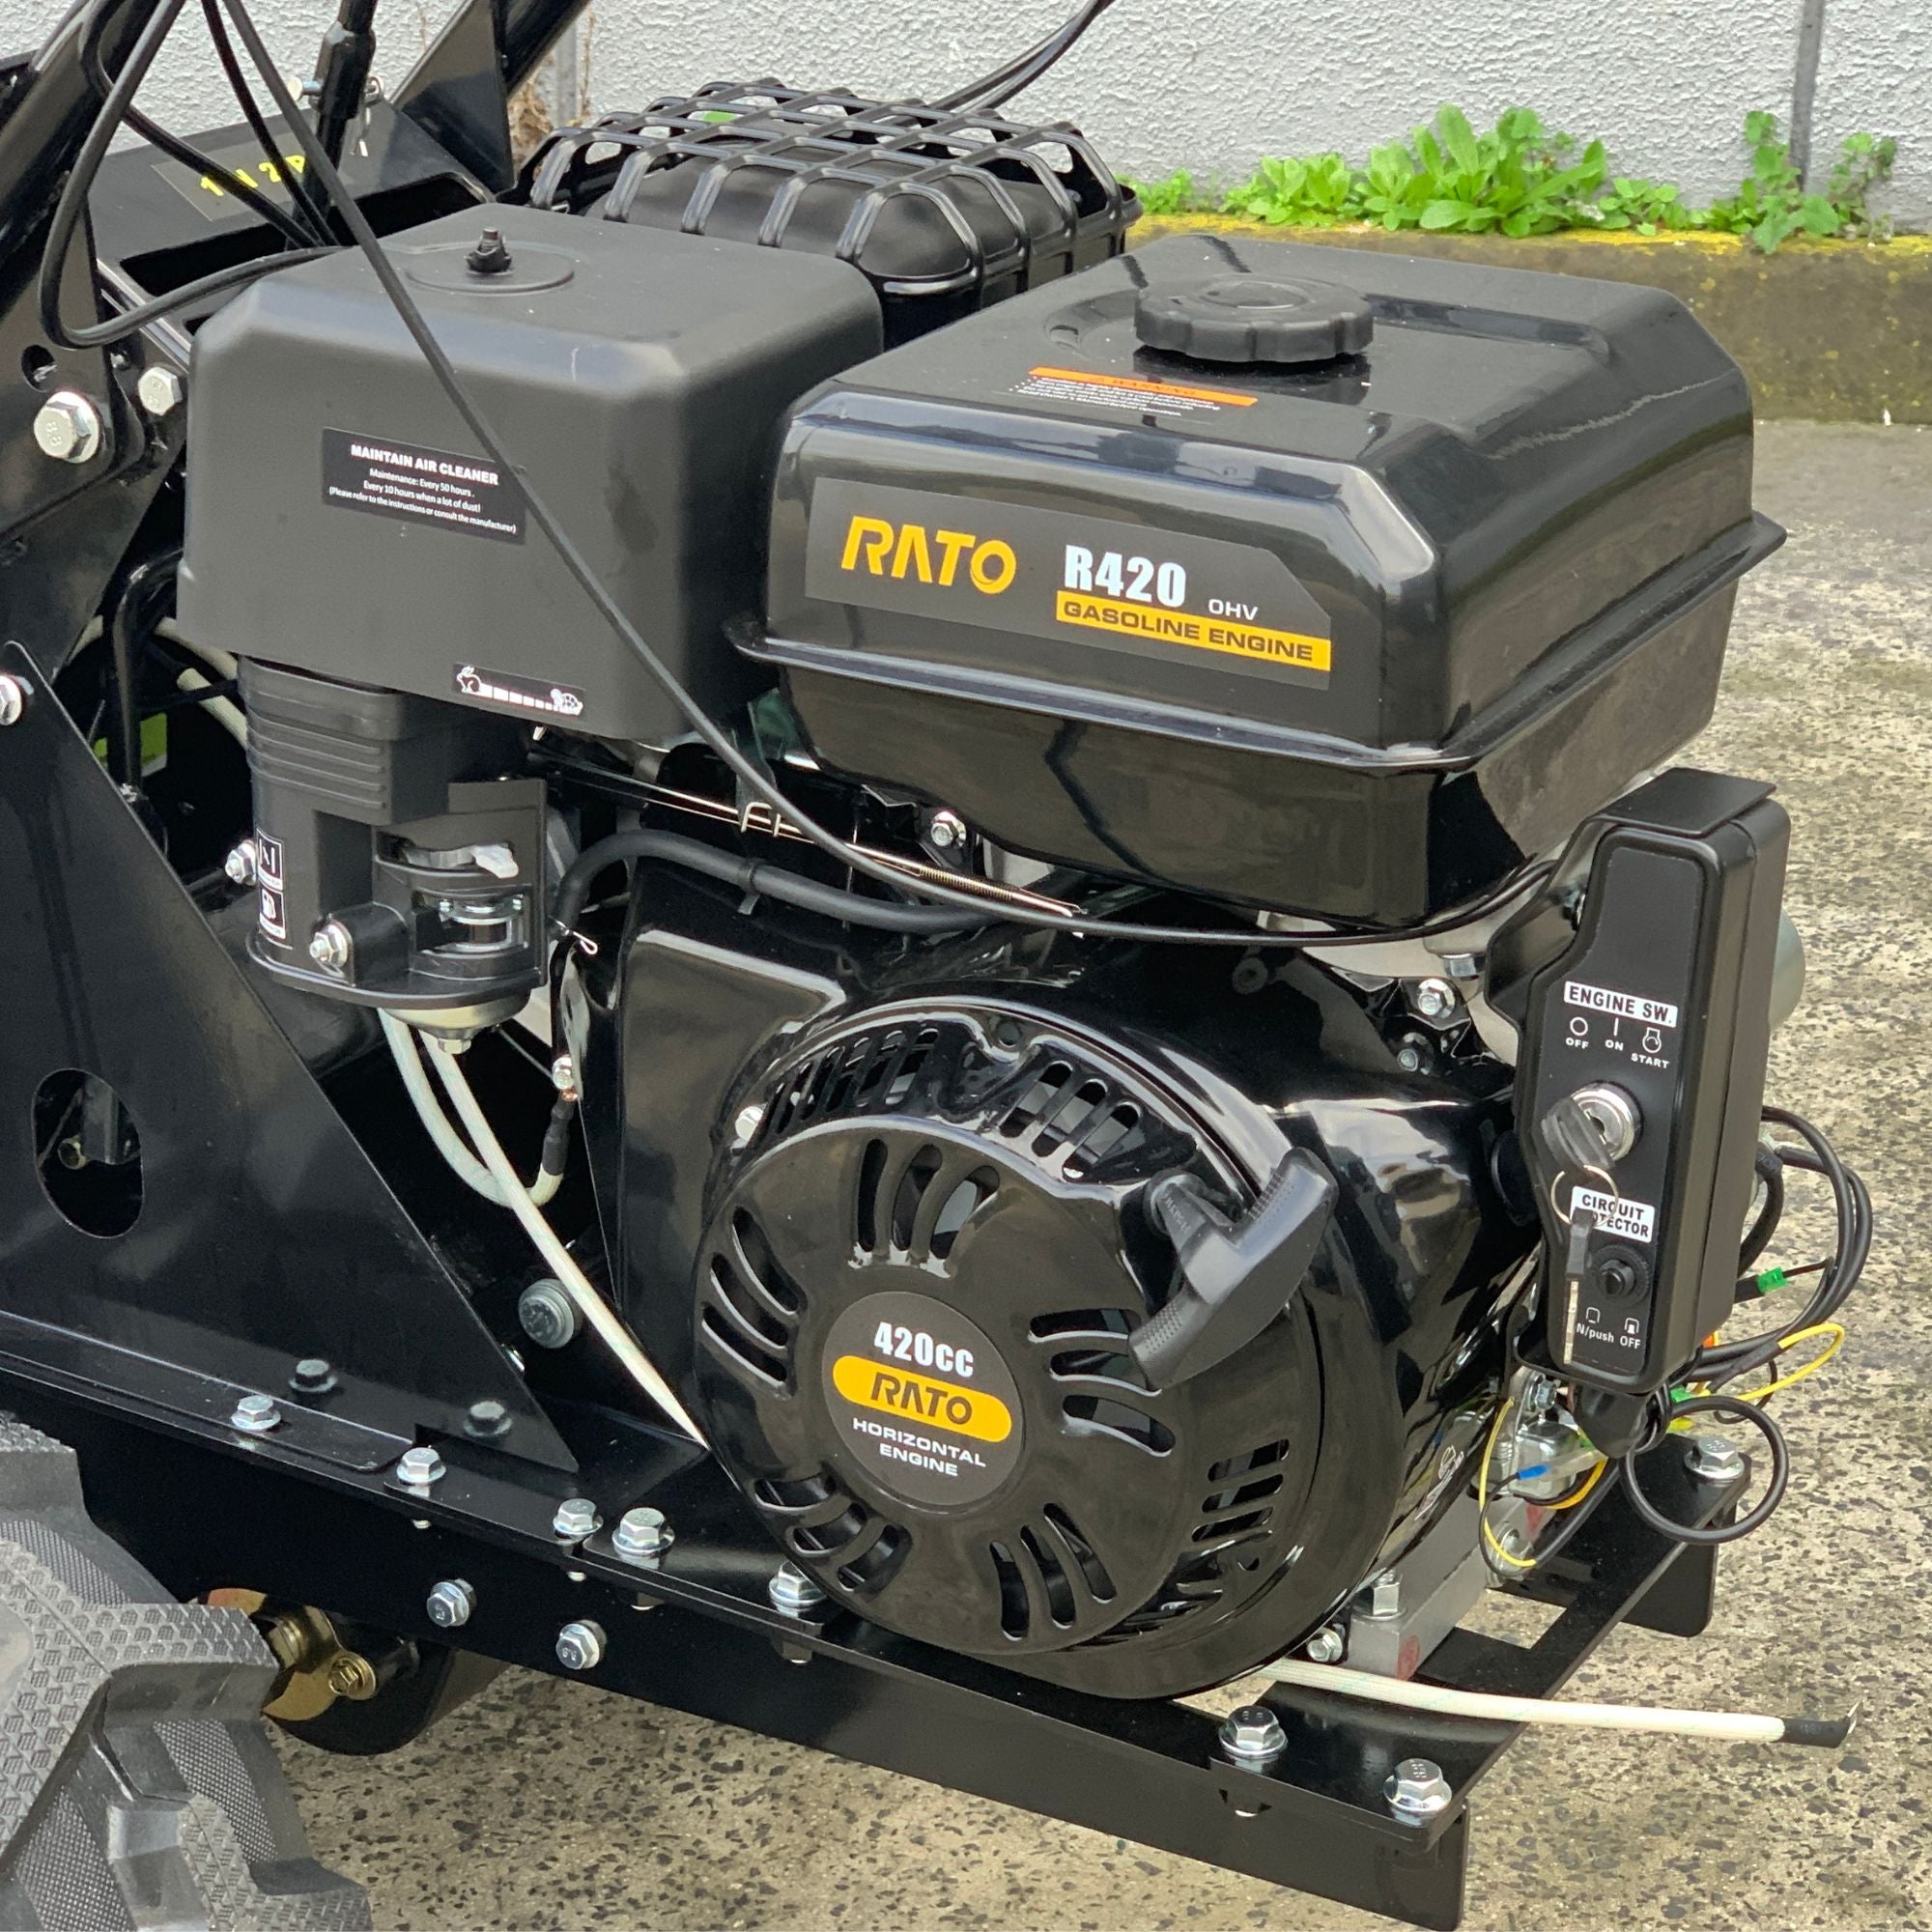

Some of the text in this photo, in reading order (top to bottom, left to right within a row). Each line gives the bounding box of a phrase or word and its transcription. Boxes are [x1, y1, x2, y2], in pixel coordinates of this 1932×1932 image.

[351, 444, 499, 486] MAINTAIN AIR CLEANER
[369, 468, 419, 486] Maintenance:
[419, 478, 440, 492] Every
[440, 482, 450, 493] 50
[328, 486, 353, 498] (Please
[353, 492, 368, 501] refer
[376, 497, 388, 506] the
[388, 498, 426, 514] instructions
[434, 509, 458, 522] consult
[458, 513, 469, 524] the
[469, 517, 517, 534] manufacturer)
[363, 479, 384, 494] Every
[384, 485, 394, 495] 10
[394, 486, 415, 498] hours
[415, 492, 437, 503] when
[441, 497, 453, 507] lot
[453, 499, 462, 508] of
[841, 516, 1016, 594] RATO
[1065, 544, 1259, 621] R420 OHV
[1064, 600, 1315, 663] GASOLINE ENGINE
[1569, 985, 1672, 1023] ENGINE SW.
[1565, 1037, 1590, 1050] OFF
[1605, 1039, 1625, 1051] ON
[1631, 1052, 1670, 1069] START
[1582, 1194, 1645, 1221] CIRCUIT
[1619, 1335, 1641, 1350] OFF
[870, 1372, 973, 1425] RATO
[852, 1417, 986, 1467] HORIZONTAL
[879, 1443, 958, 1477] ENGINE
